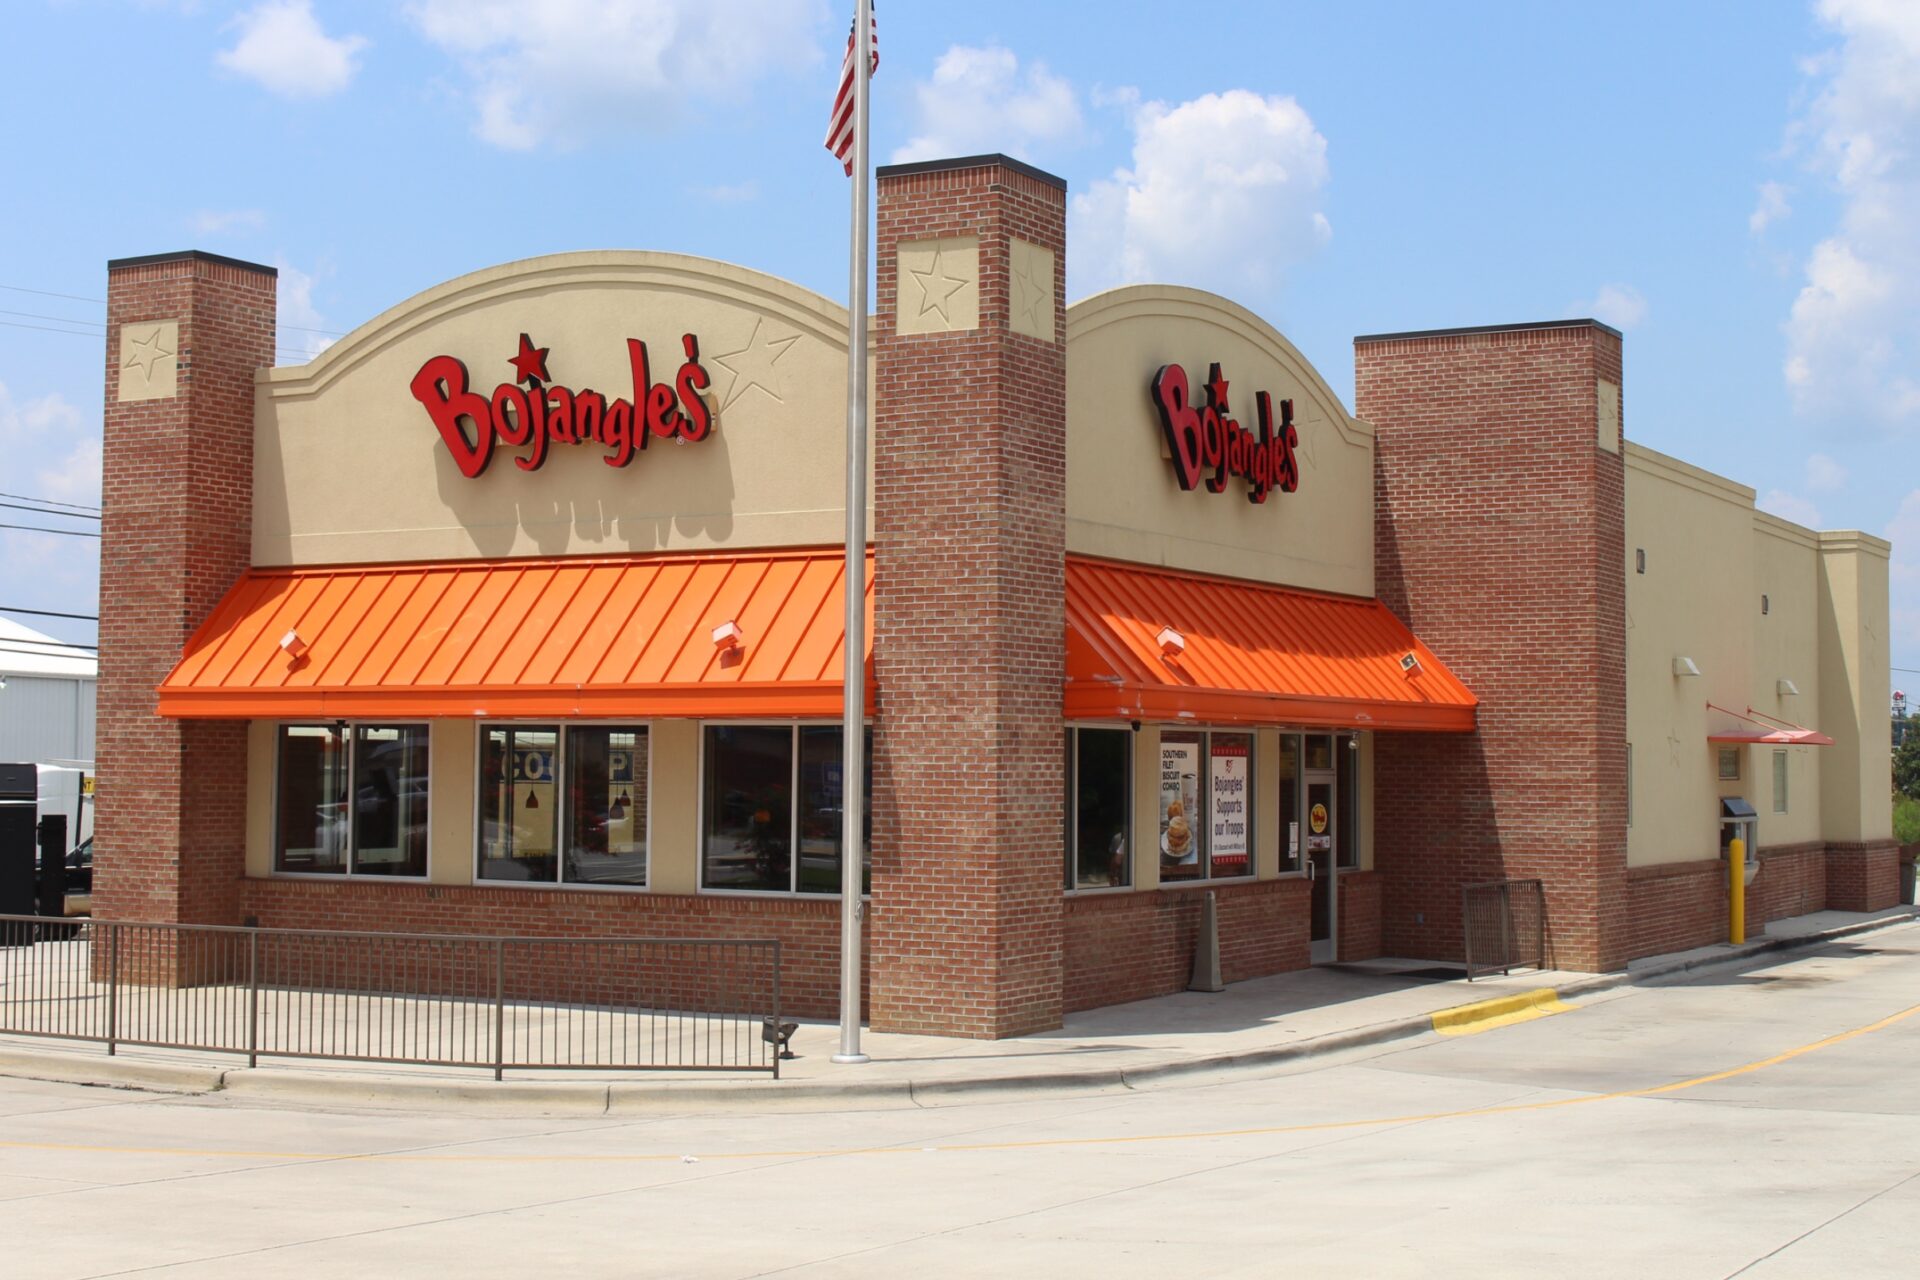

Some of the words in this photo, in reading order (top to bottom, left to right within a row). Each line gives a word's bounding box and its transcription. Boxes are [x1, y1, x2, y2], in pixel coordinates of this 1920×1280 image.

[1162, 750, 1188, 759] SOUTHERN
[1162, 760, 1174, 769] FILET
[1162, 771, 1180, 780] BISCUIT
[1162, 782, 1180, 791] COMBO
[1216, 798, 1242, 817] Supports
[1215, 823, 1224, 836] our
[1225, 819, 1244, 838] Troops
